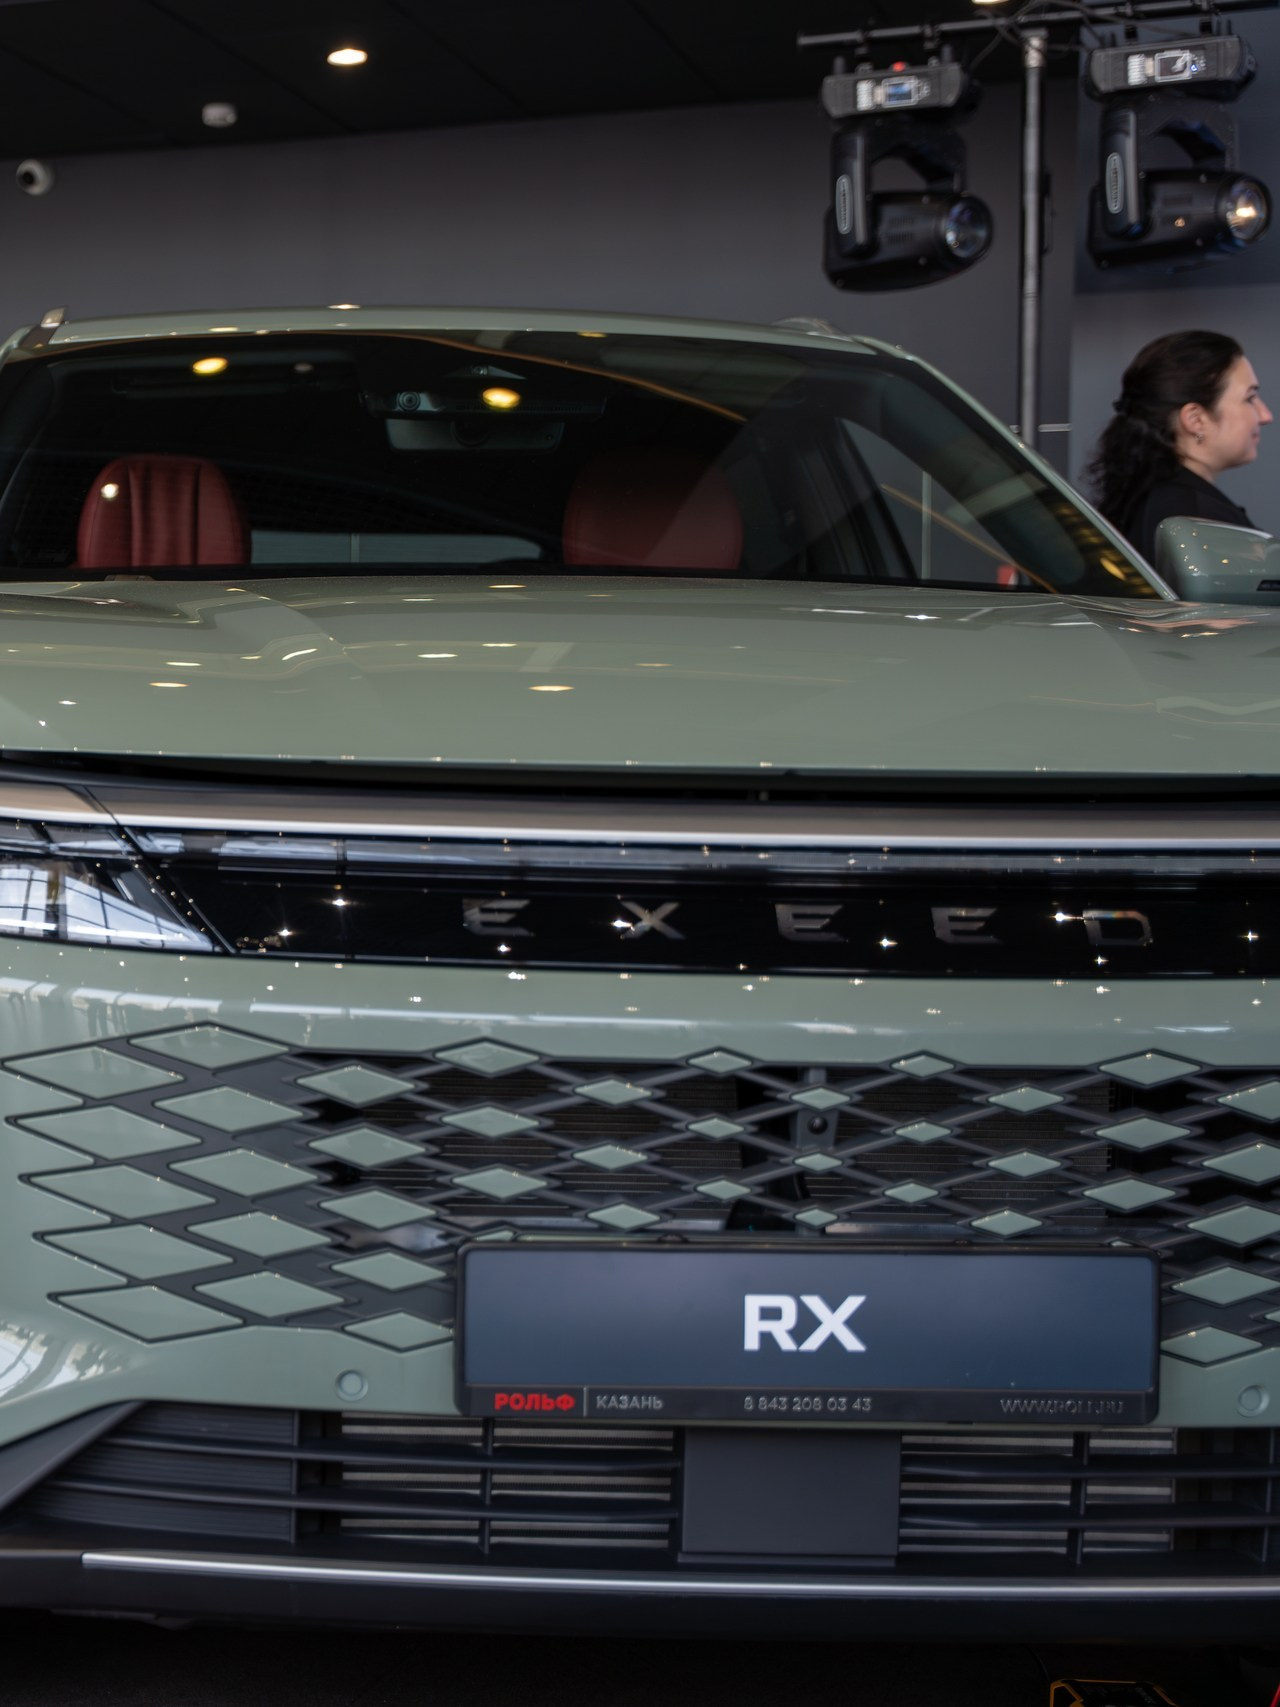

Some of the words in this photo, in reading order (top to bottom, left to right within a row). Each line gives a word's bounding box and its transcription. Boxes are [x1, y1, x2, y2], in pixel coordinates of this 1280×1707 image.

[461, 898, 1154, 947] EXEED
[743, 1294, 867, 1353] RX
[493, 1392, 576, 1412] РОЛЬФ
[596, 1395, 663, 1410] КАЗАНЬ
[743, 1396, 754, 1411] 8
[757, 1396, 788, 1411] 843
[792, 1397, 822, 1412] 208
[826, 1397, 848, 1412] 03
[851, 1397, 872, 1412] 43
